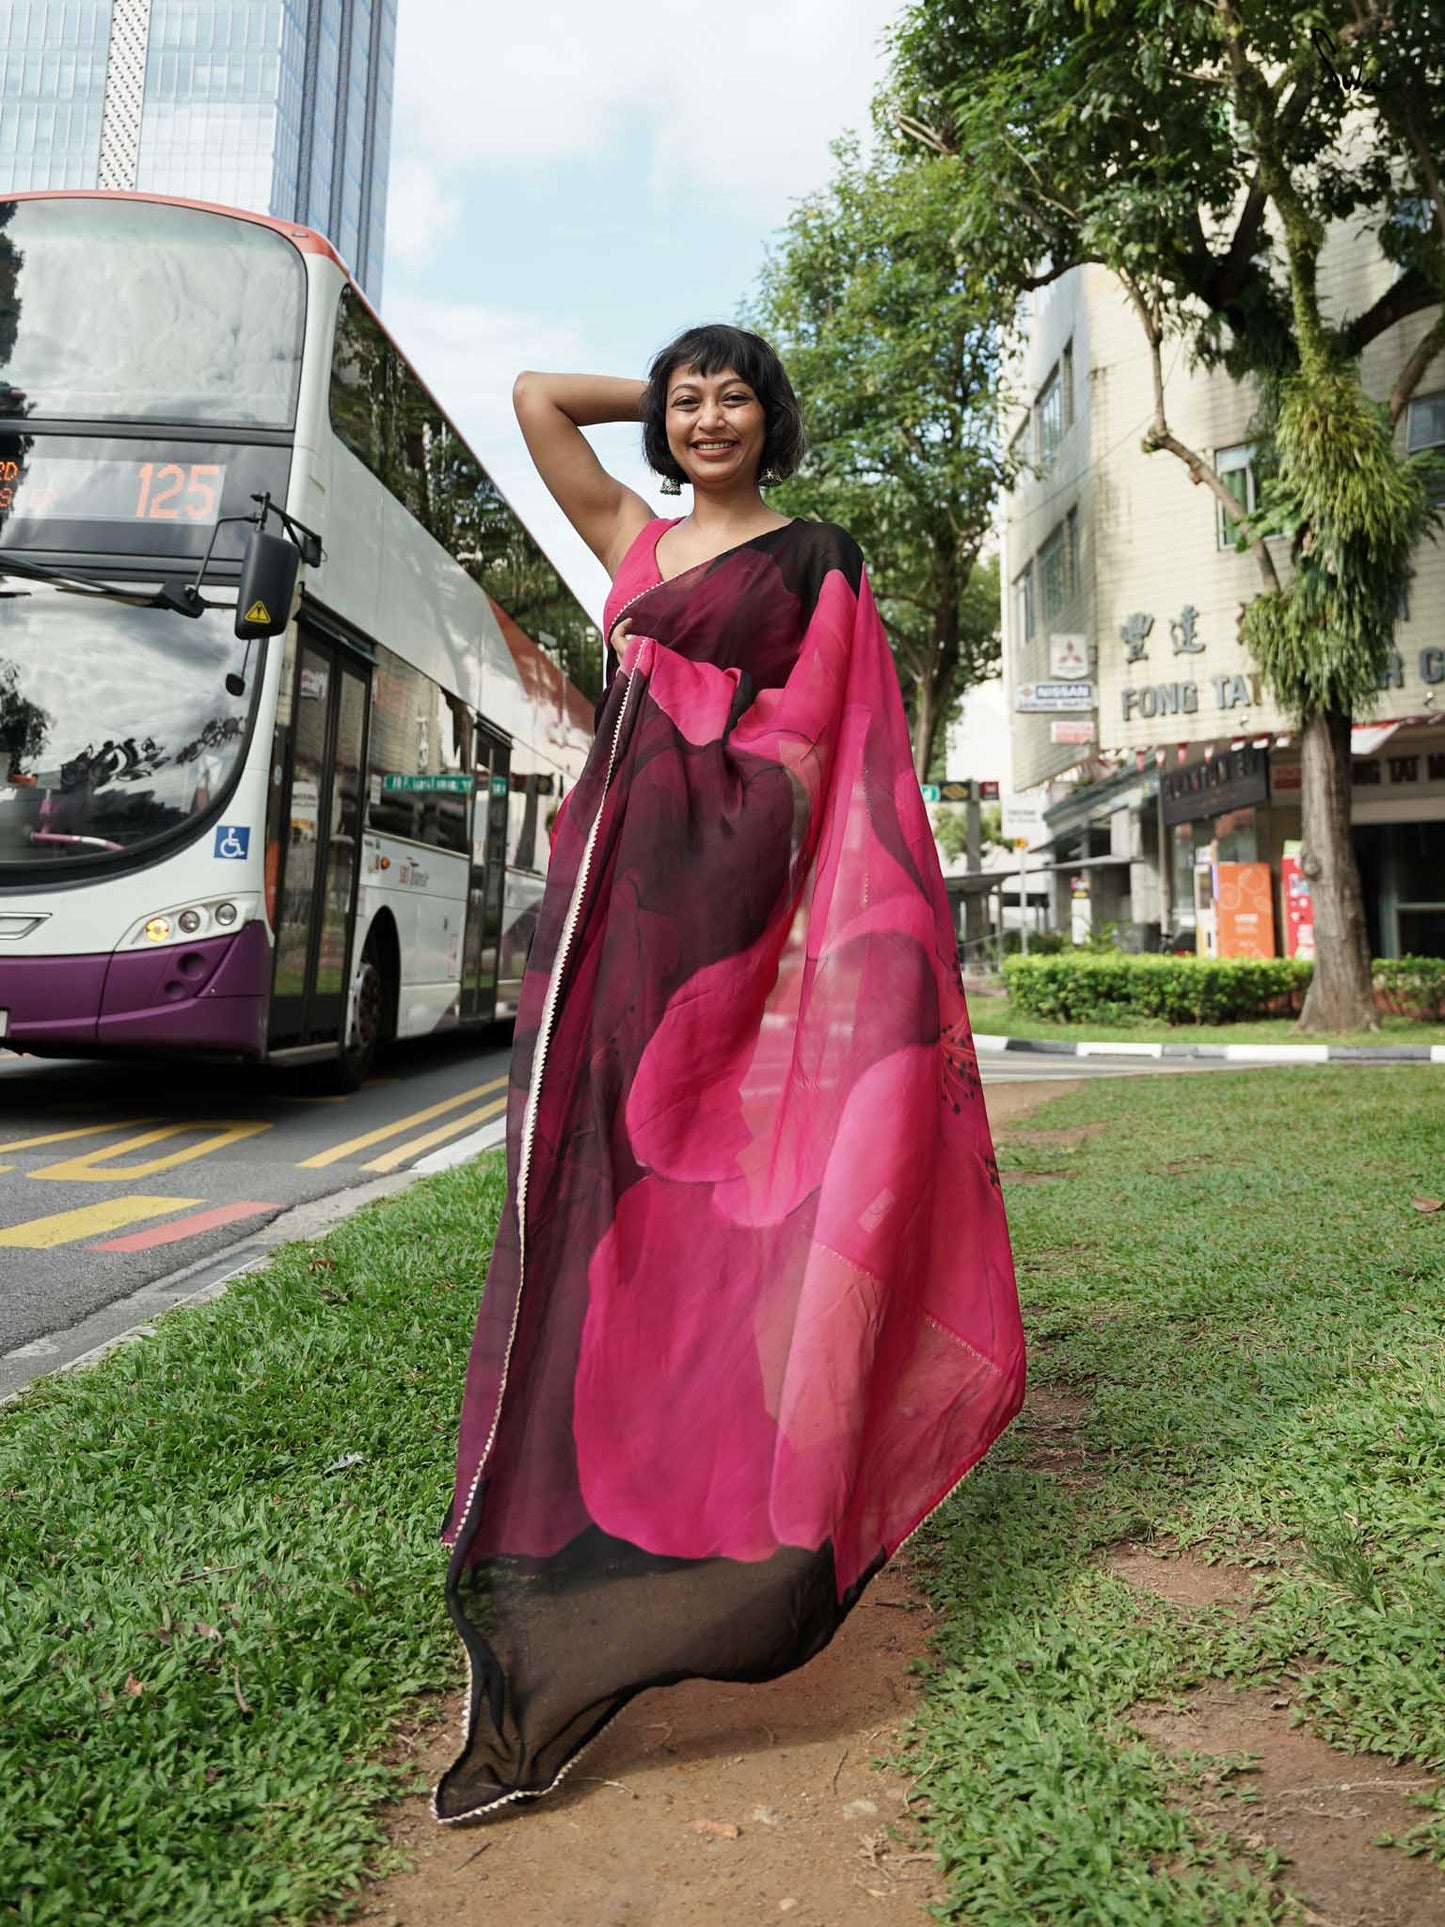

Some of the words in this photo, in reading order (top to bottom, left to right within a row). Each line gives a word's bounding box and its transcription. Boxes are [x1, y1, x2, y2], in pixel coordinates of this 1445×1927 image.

[136, 463, 220, 520] 125
[1037, 685, 1090, 698] NISSAN
[1121, 681, 1199, 722] FONG
